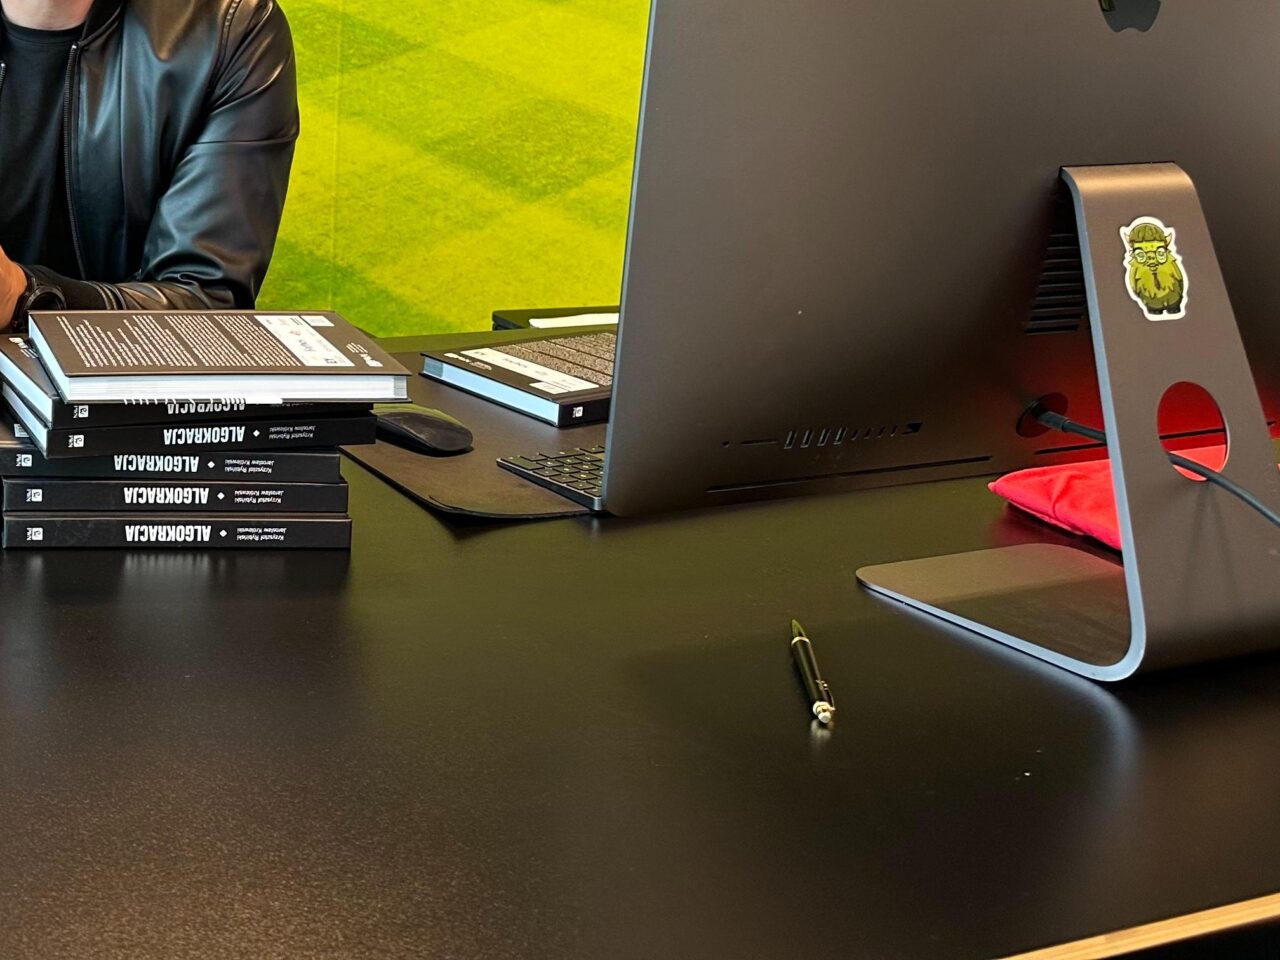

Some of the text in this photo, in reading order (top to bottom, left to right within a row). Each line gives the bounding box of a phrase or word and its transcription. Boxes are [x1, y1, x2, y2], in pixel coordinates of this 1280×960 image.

[163, 426, 246, 445] ALGOKRACJA
[114, 455, 200, 472] ALGOKRACJA
[123, 487, 210, 504] ALGOKRACJA
[125, 525, 212, 542] ALGOKRACJA
